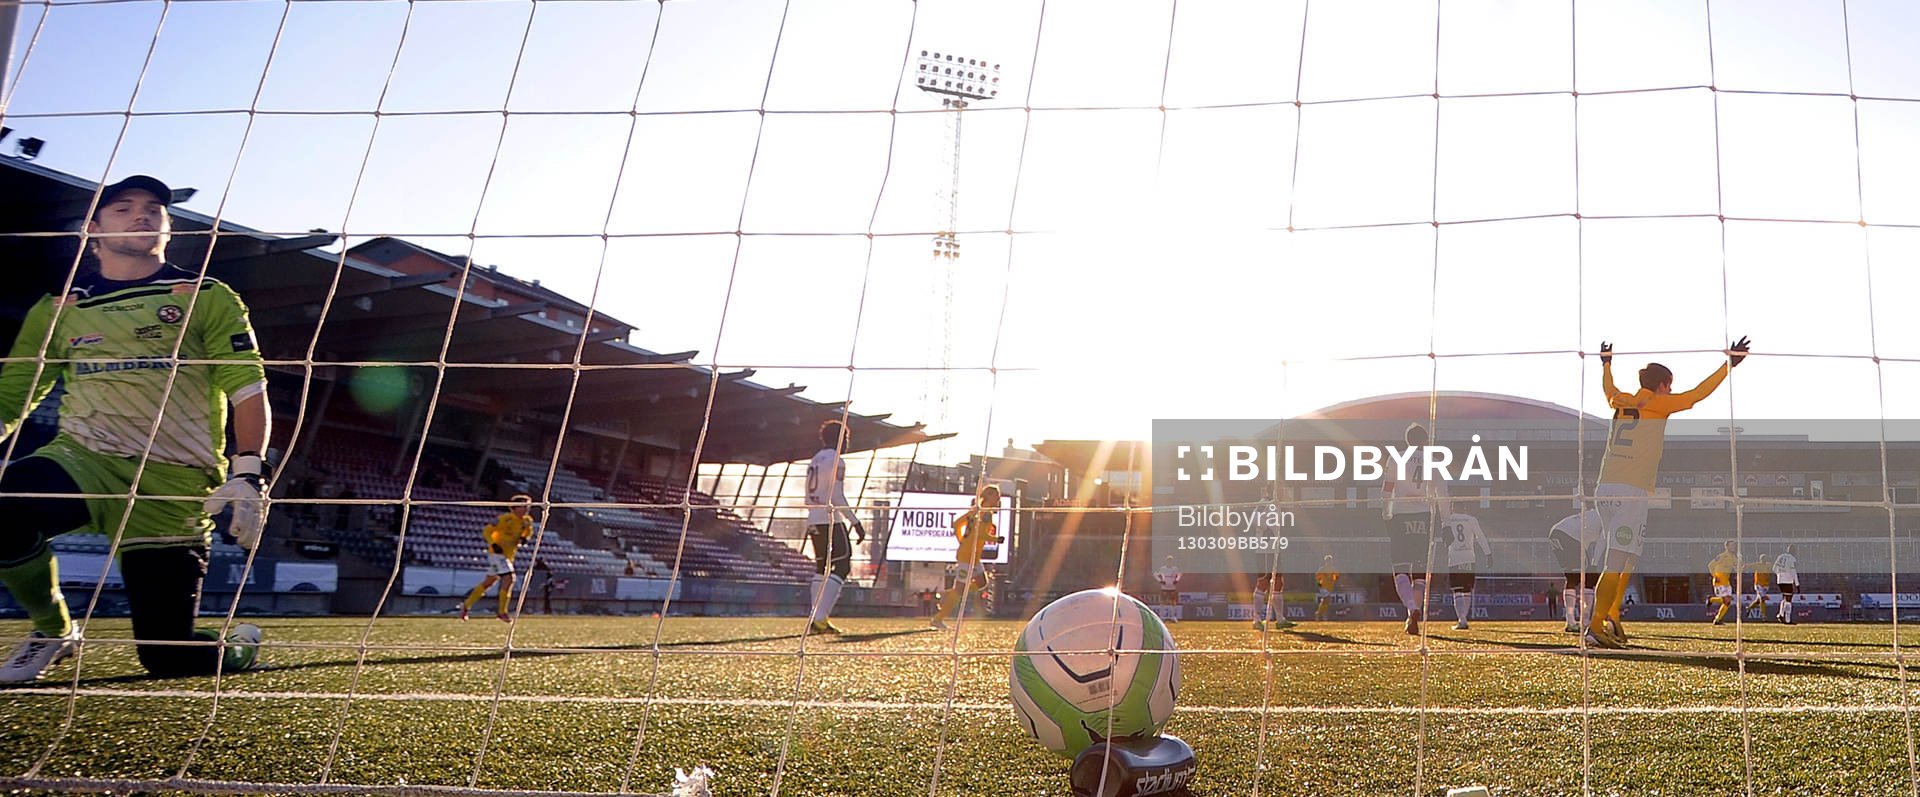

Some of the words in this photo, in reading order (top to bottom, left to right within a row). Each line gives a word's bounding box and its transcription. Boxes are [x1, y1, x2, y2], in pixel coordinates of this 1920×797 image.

[902, 510, 957, 528] MOBILT
[1456, 523, 1465, 542] 8
[1196, 606, 1215, 617] NA
[1287, 607, 1305, 618] NA
[1379, 607, 1397, 618] NA
[1471, 607, 1489, 618] NA
[1656, 607, 1675, 619] NA
